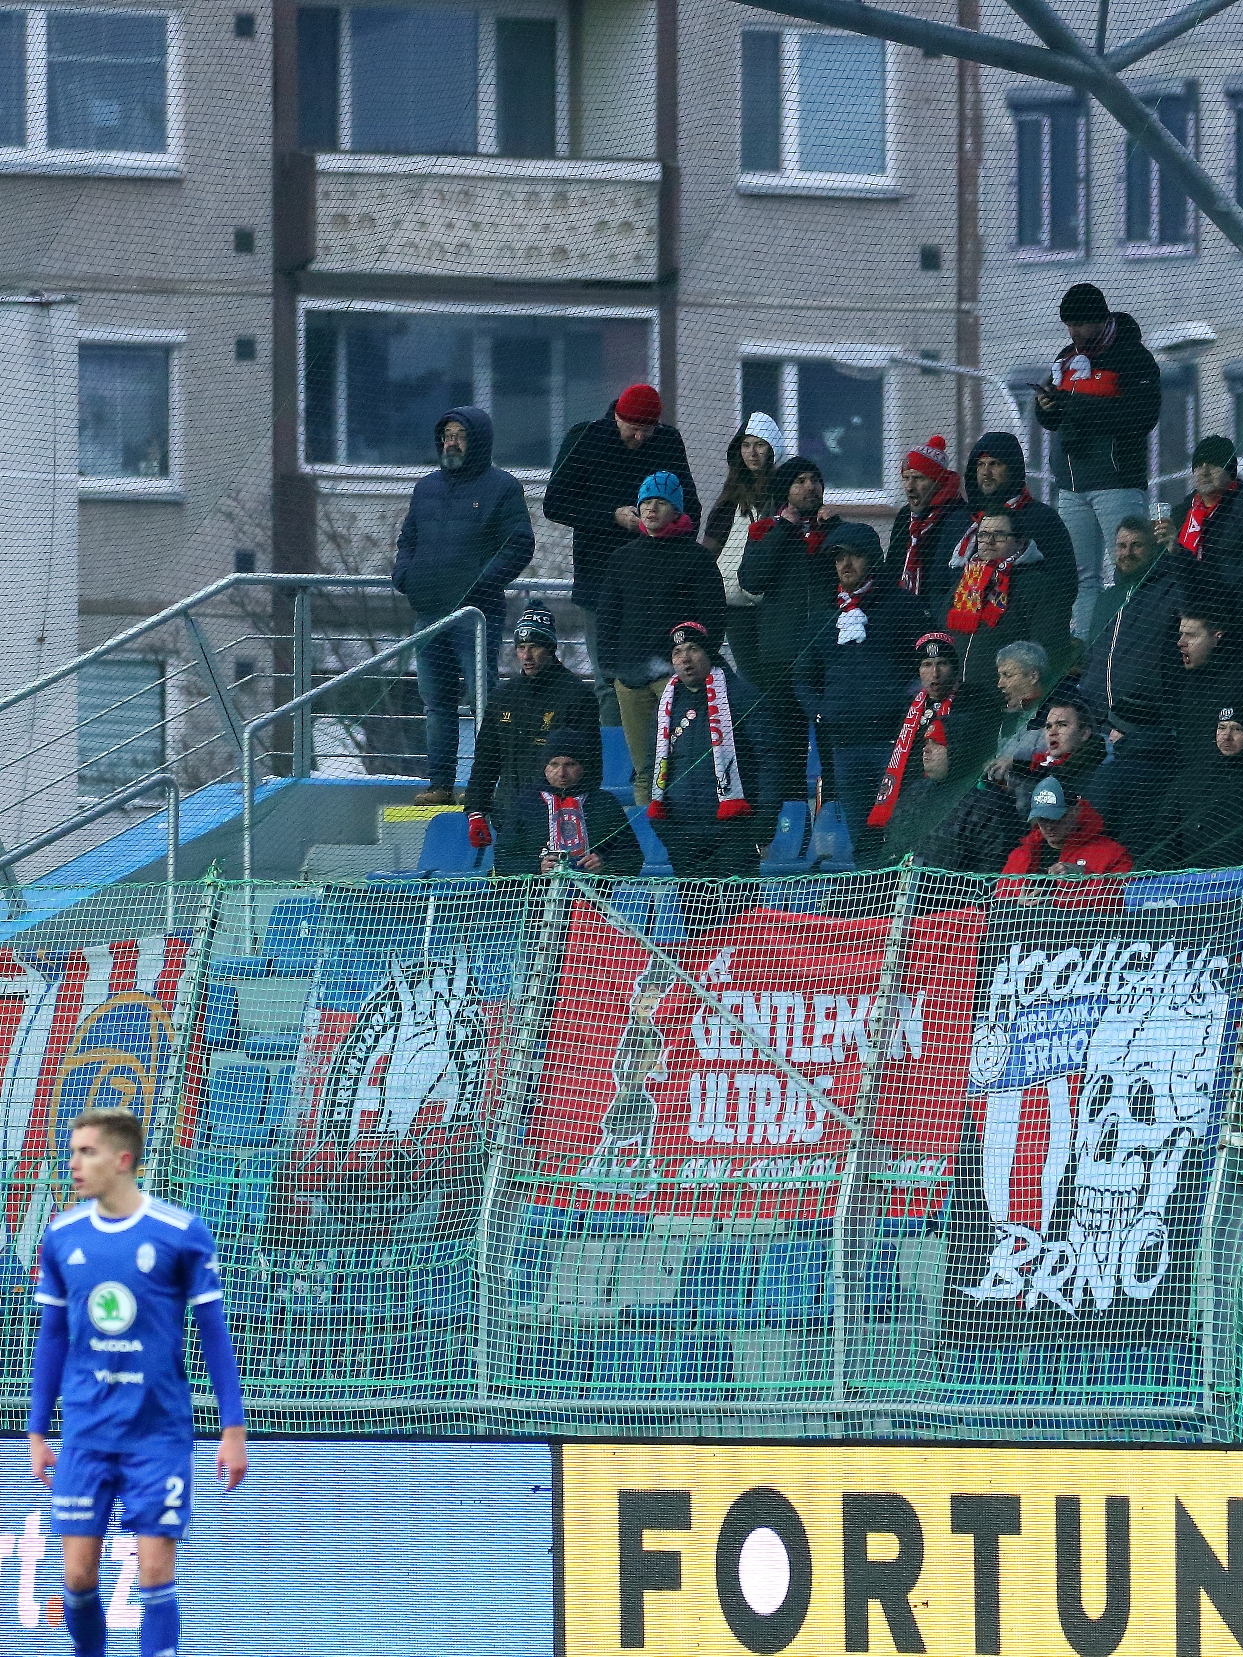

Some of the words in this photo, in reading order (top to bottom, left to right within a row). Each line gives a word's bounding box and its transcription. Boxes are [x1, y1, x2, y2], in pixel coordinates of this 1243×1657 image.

[988, 941, 1229, 1026] HOOLIGANS
[1024, 1031, 1090, 1075] BRNO
[688, 1072, 835, 1146] ULTRAS
[953, 1216, 1170, 1318] BRNO
[164, 1475, 186, 1507] 2
